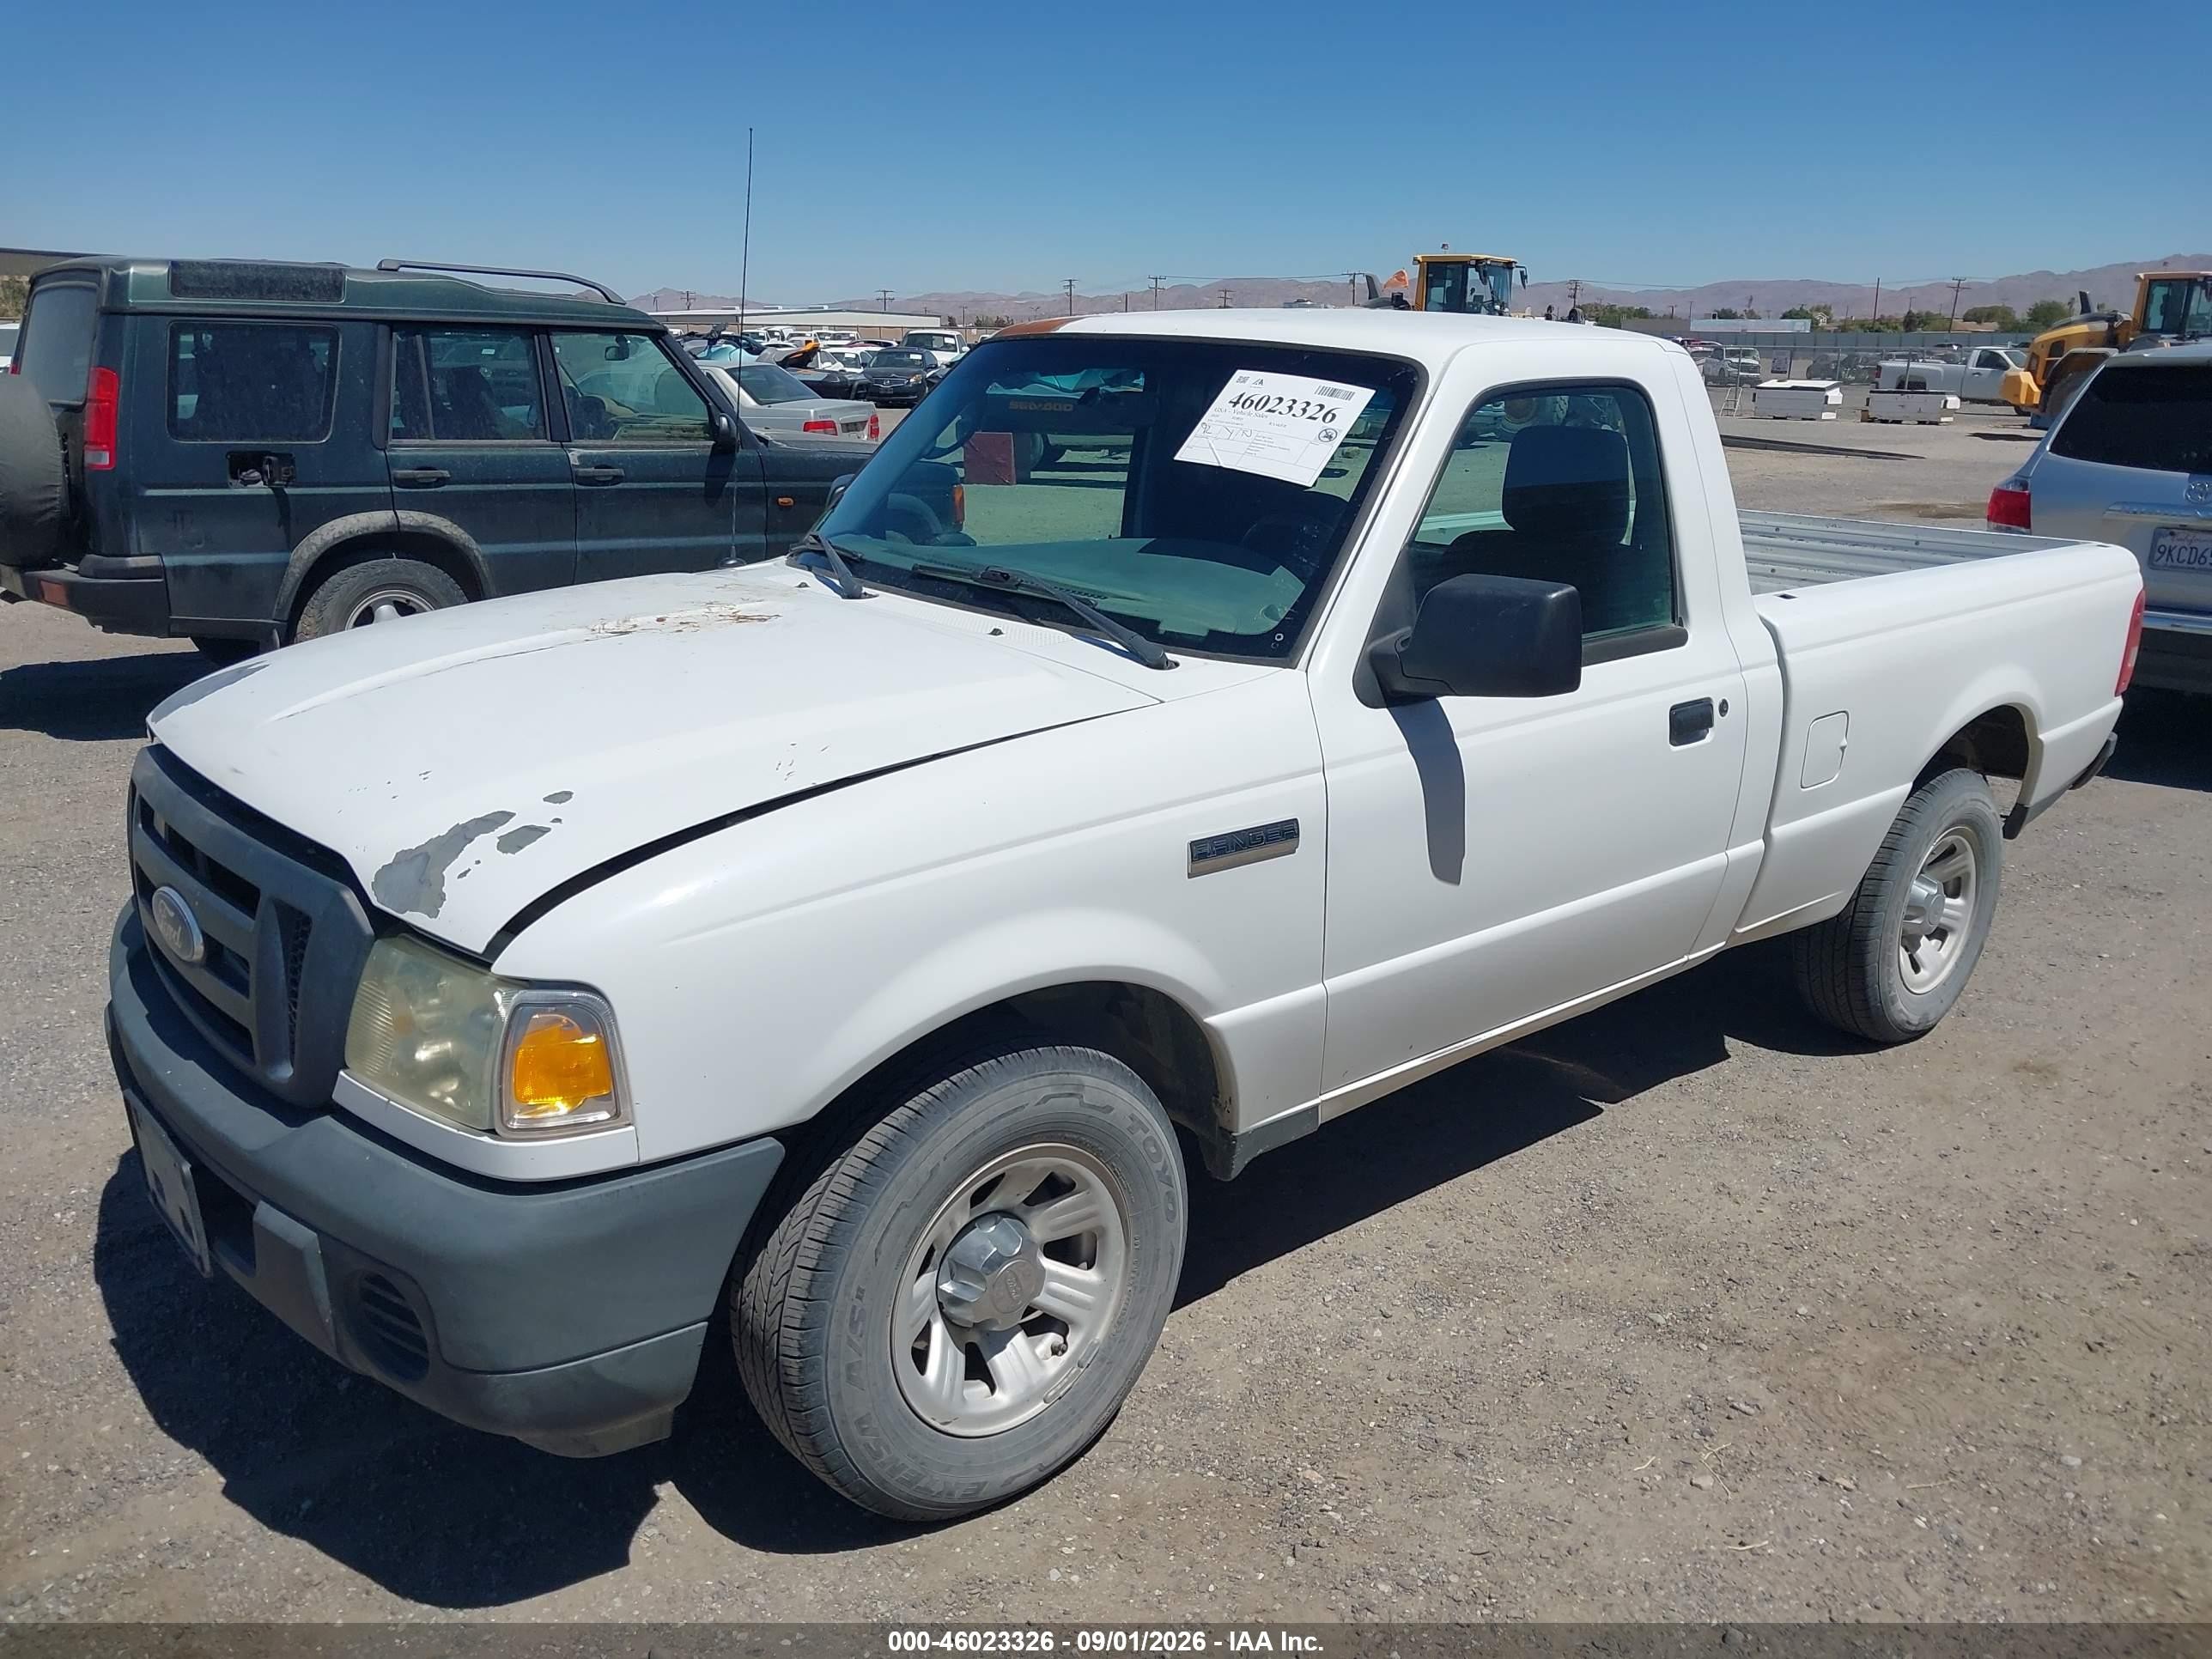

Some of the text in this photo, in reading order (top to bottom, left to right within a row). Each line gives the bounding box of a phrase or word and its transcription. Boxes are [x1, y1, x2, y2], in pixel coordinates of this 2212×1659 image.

[1228, 392, 1342, 425] 46023326
[1191, 822, 1299, 861] RANGER
[1125, 1113, 1177, 1224] TOYO
